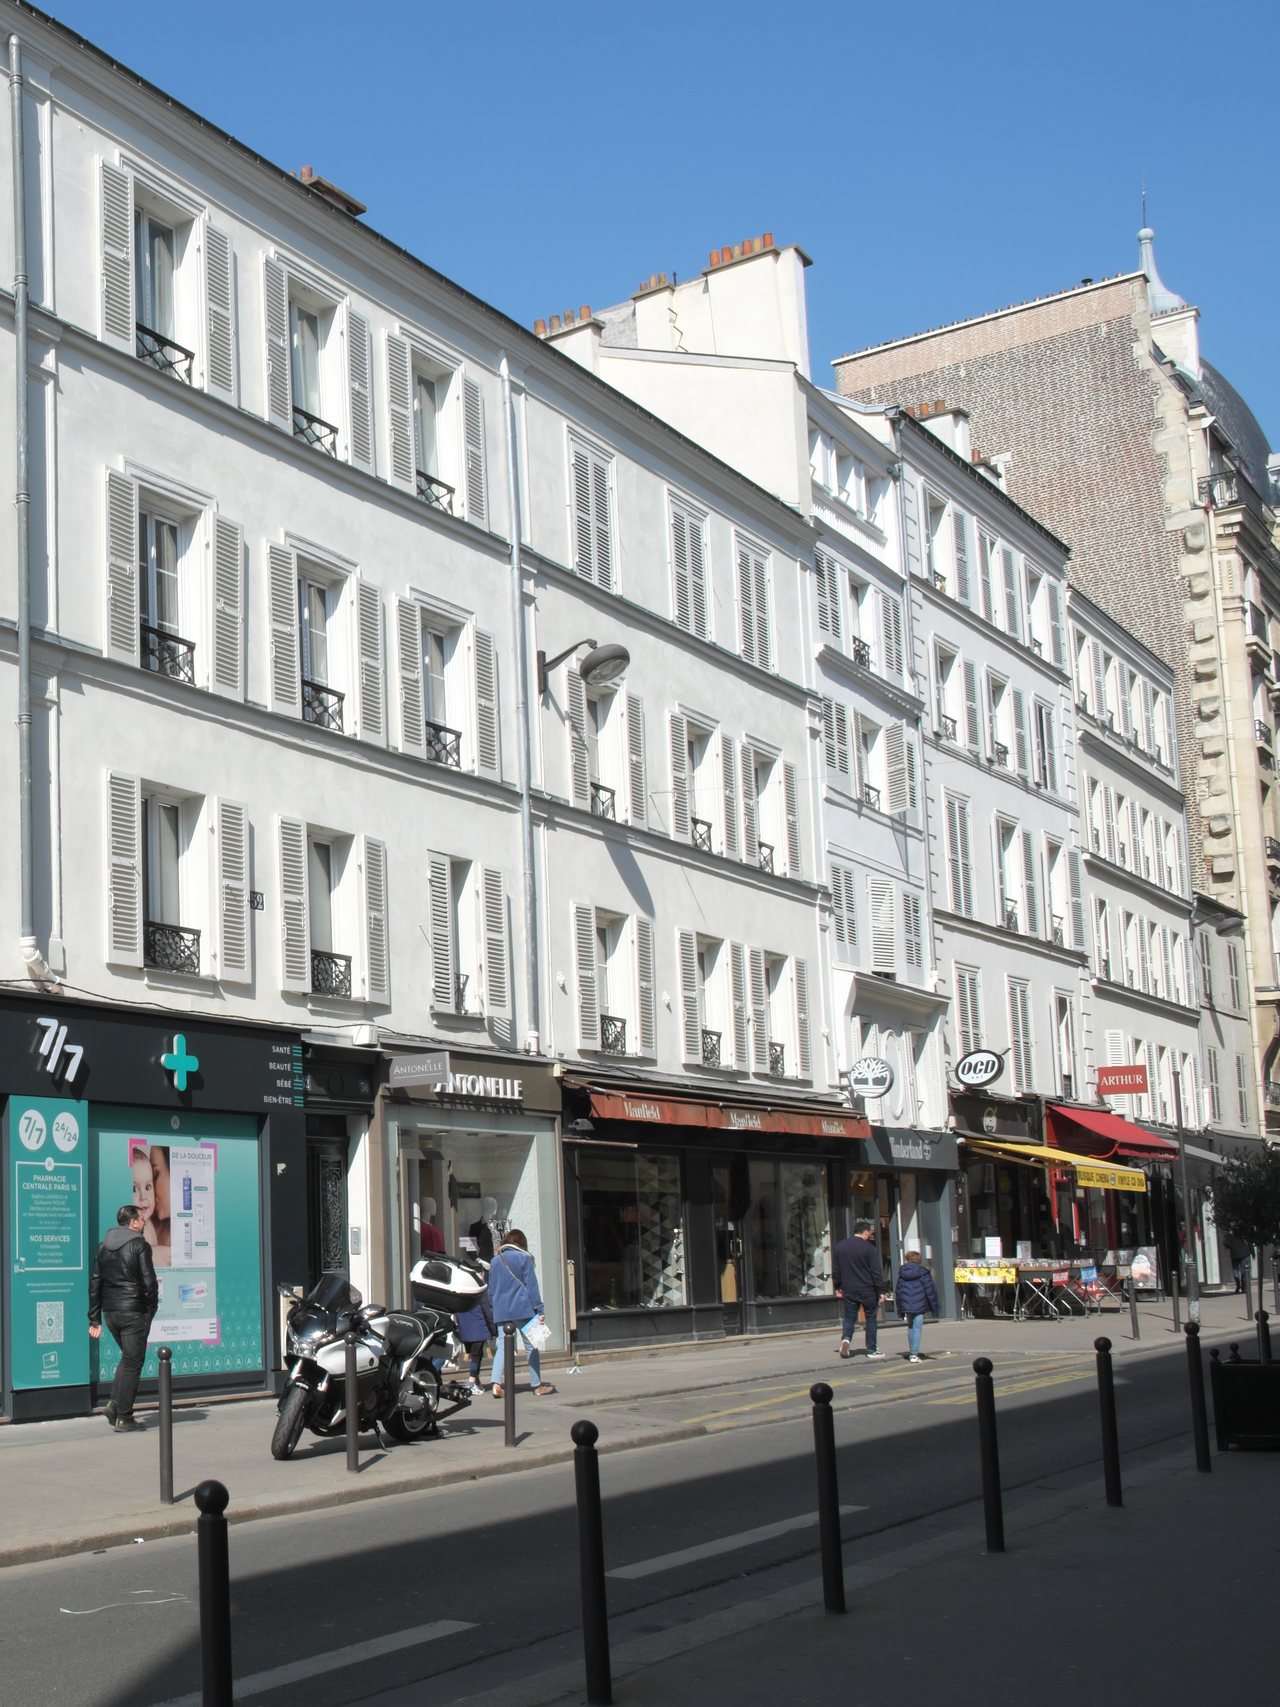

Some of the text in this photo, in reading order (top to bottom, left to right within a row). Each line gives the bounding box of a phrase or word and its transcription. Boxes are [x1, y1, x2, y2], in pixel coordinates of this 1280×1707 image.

[36, 1017, 84, 1083] 7/7
[272, 1045, 290, 1055] SANTÉ
[269, 1062, 291, 1072] BEAUTÉ
[393, 1062, 442, 1075] ANTONELLE
[961, 1060, 996, 1075] OCD
[276, 1078, 292, 1088] BÉBÉ
[1101, 1074, 1143, 1086] ARTHUR
[264, 1095, 292, 1104] BIEN-ÊTRE
[24, 1116, 44, 1144] 7/7
[55, 1122, 78, 1142] 24/24
[33, 1174, 66, 1182] PHARMACIE
[22, 1182, 52, 1190] CENTRALE
